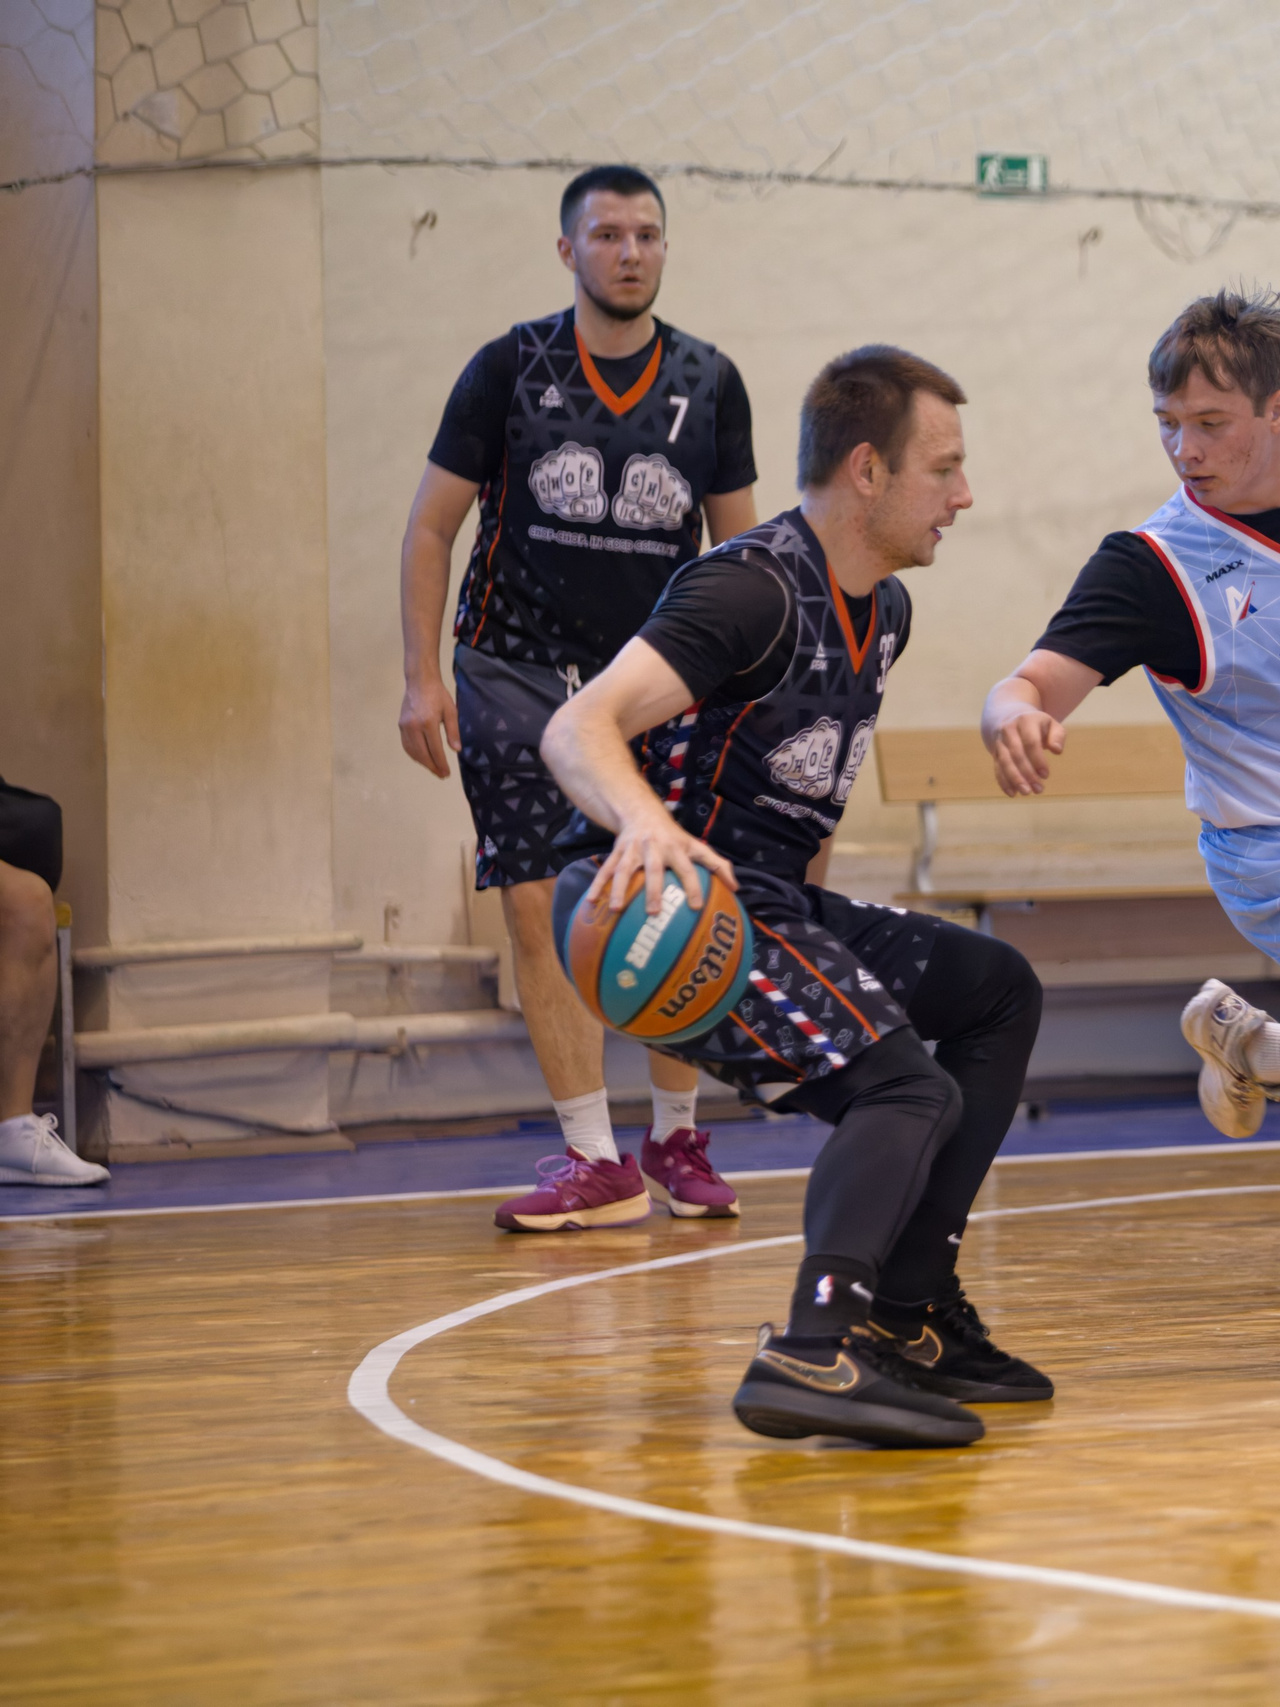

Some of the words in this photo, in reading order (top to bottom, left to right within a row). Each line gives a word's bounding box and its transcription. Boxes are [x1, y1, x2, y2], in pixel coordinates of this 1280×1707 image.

[667, 395, 690, 443] 7
[1205, 559, 1244, 583] MAXX
[658, 911, 737, 1018] Wilson
